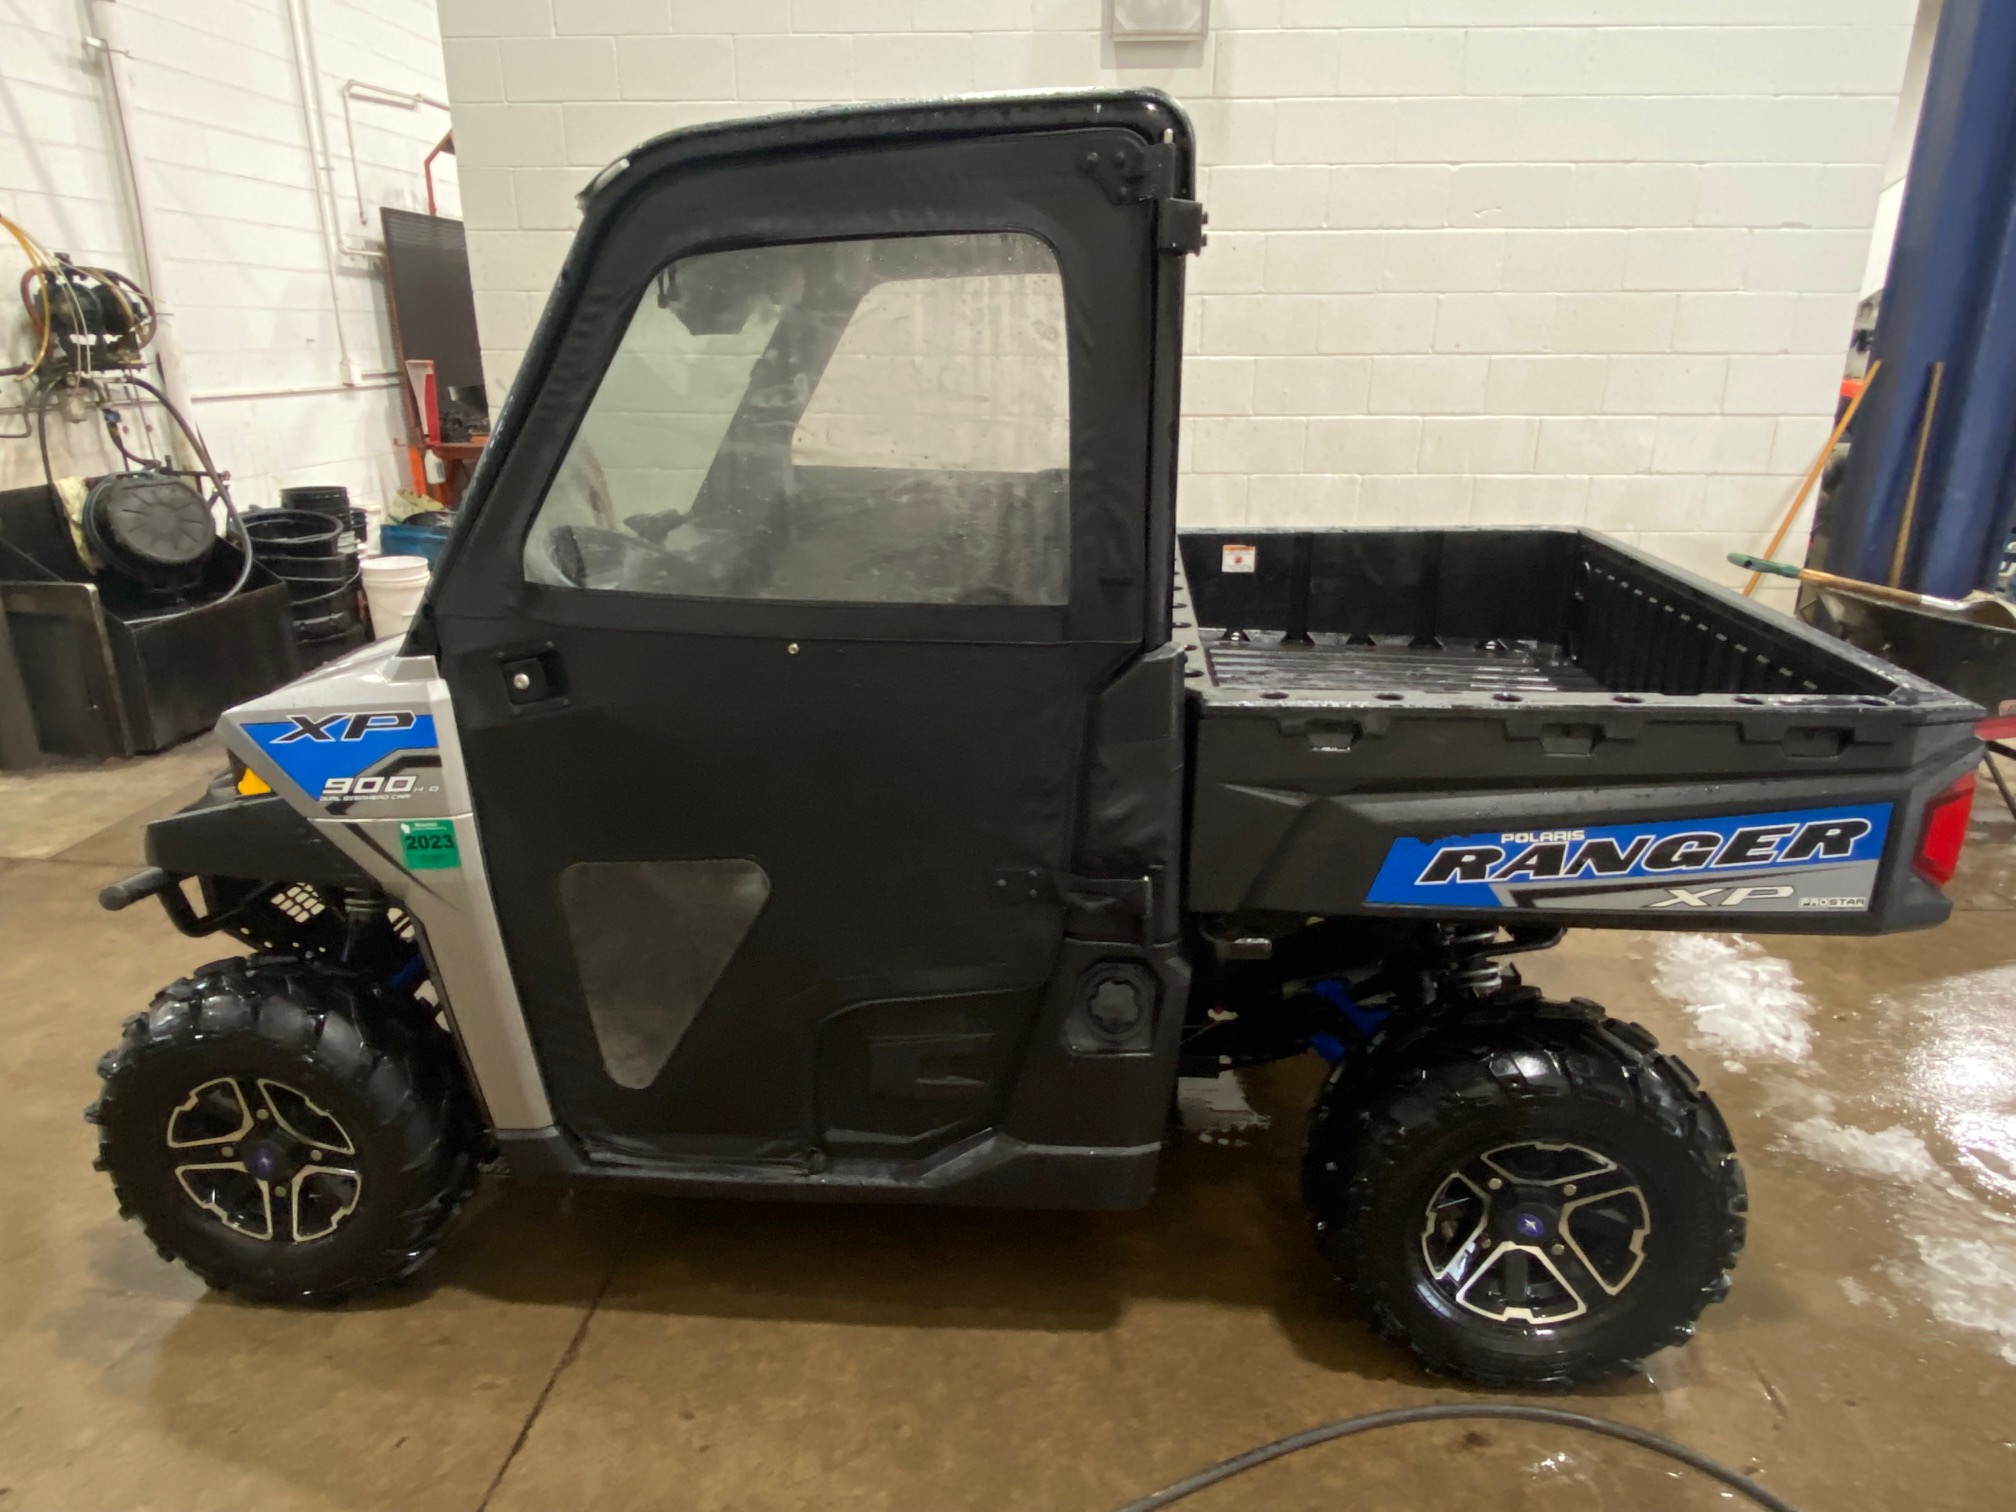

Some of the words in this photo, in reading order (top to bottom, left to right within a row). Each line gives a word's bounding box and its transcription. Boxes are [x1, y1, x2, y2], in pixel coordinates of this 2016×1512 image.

[268, 710, 417, 744] XP
[322, 776, 417, 794] 900
[405, 834, 455, 850] 2023
[1500, 829, 1586, 844] POLARIS
[1414, 818, 1872, 886] RANGER
[1643, 884, 1796, 909] XP
